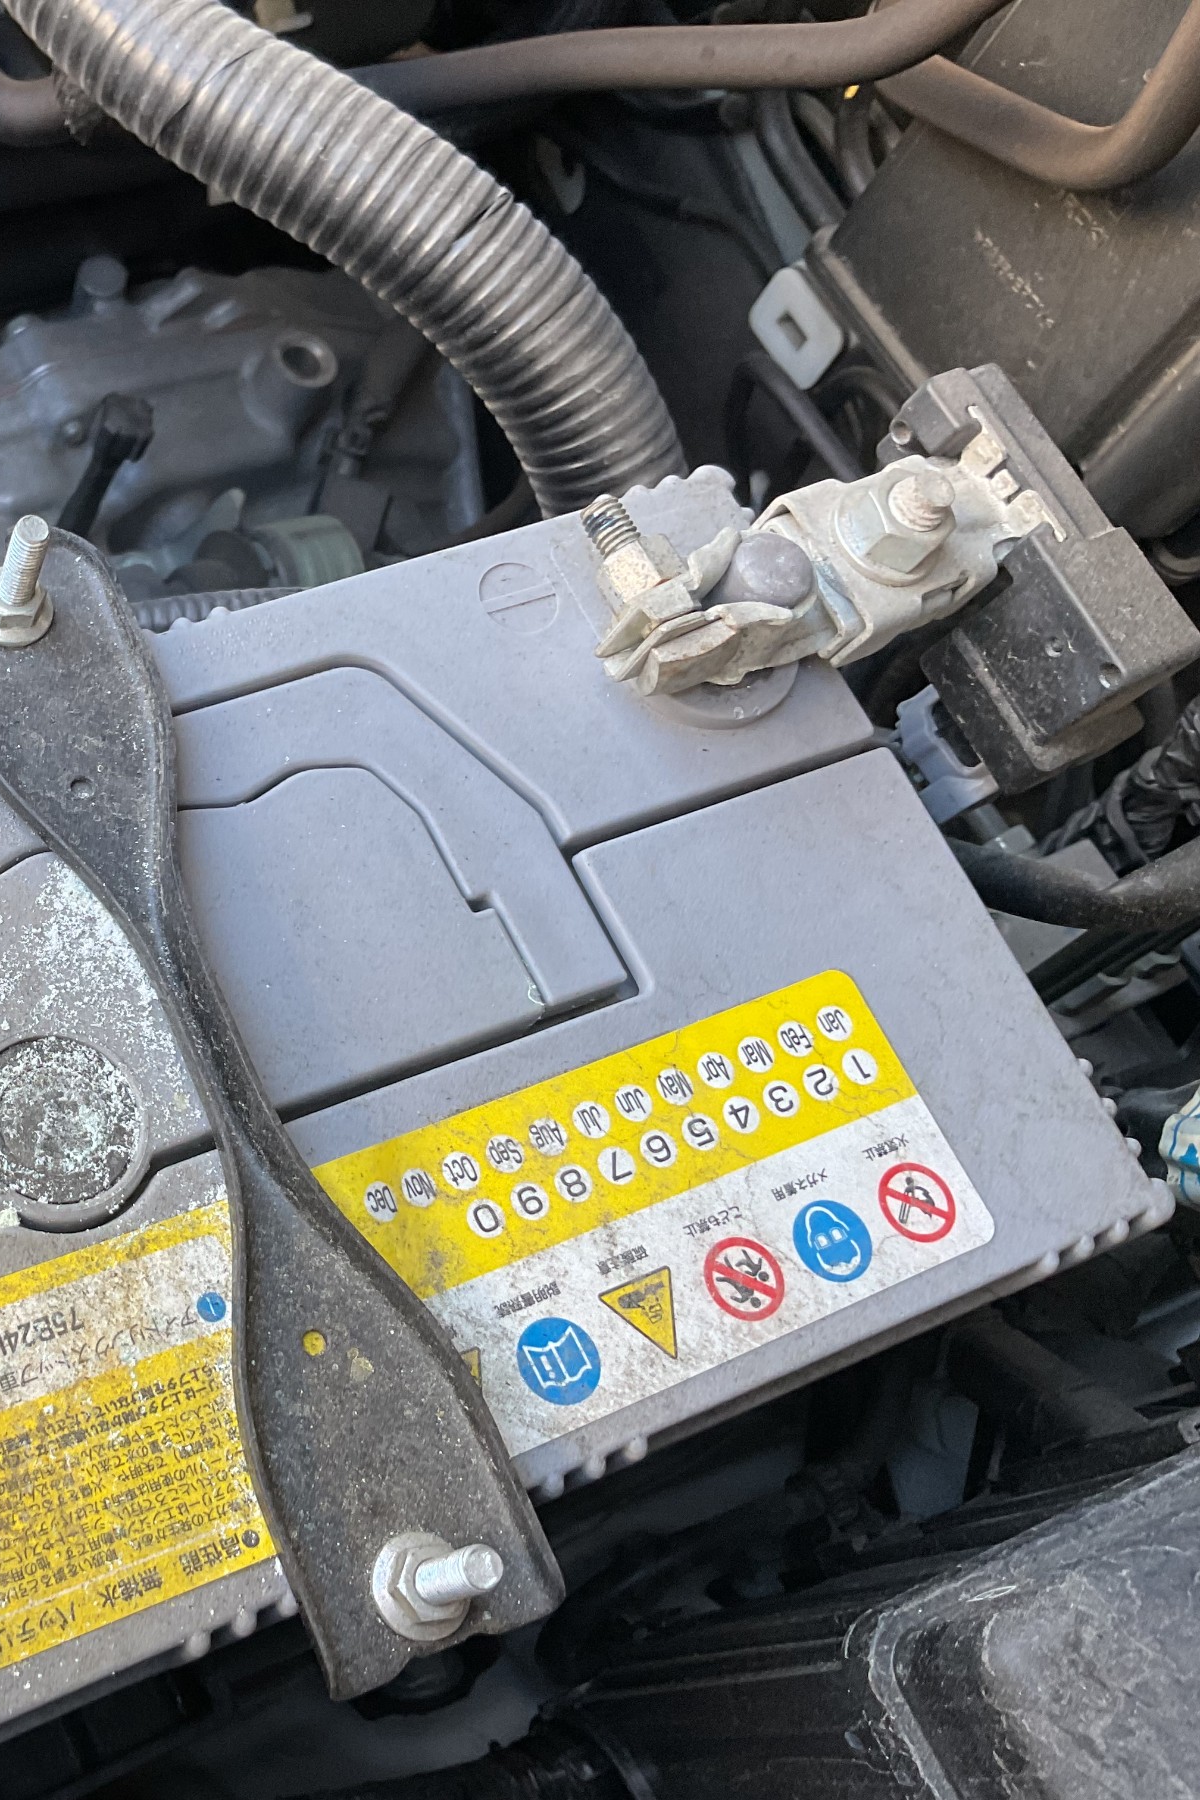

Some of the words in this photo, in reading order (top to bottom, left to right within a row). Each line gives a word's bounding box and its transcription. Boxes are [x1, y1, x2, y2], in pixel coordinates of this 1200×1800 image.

[818, 1009, 846, 1033] Jan
[780, 1024, 812, 1052] Feb
[741, 1040, 773, 1066] Mar
[851, 1055, 870, 1078] 1
[702, 1055, 730, 1081] Apr
[806, 1068, 833, 1095] 2
[658, 1071, 694, 1098] May
[768, 1085, 793, 1112] 3
[616, 1088, 645, 1113] Jun
[580, 1106, 601, 1134] Jul
[729, 1104, 749, 1128] 4
[529, 1124, 563, 1148] Aug
[687, 1118, 714, 1146] 5
[489, 1138, 522, 1164] Sep
[646, 1135, 670, 1162] 6
[863, 1134, 910, 1162] 火気禁止
[443, 1156, 477, 1185] Oct
[612, 1151, 632, 1181] 7
[404, 1171, 436, 1199] Nov
[560, 1169, 586, 1196] 8
[771, 1168, 830, 1202] メガネ着用
[366, 1185, 397, 1213] Dec
[517, 1186, 542, 1214] 9
[473, 1204, 499, 1232] 0
[683, 1204, 743, 1237] こども禁止
[595, 1243, 650, 1276] 硫酸注意
[178, 1531, 242, 1578] 高性能
[94, 1563, 163, 1612] 無補水
